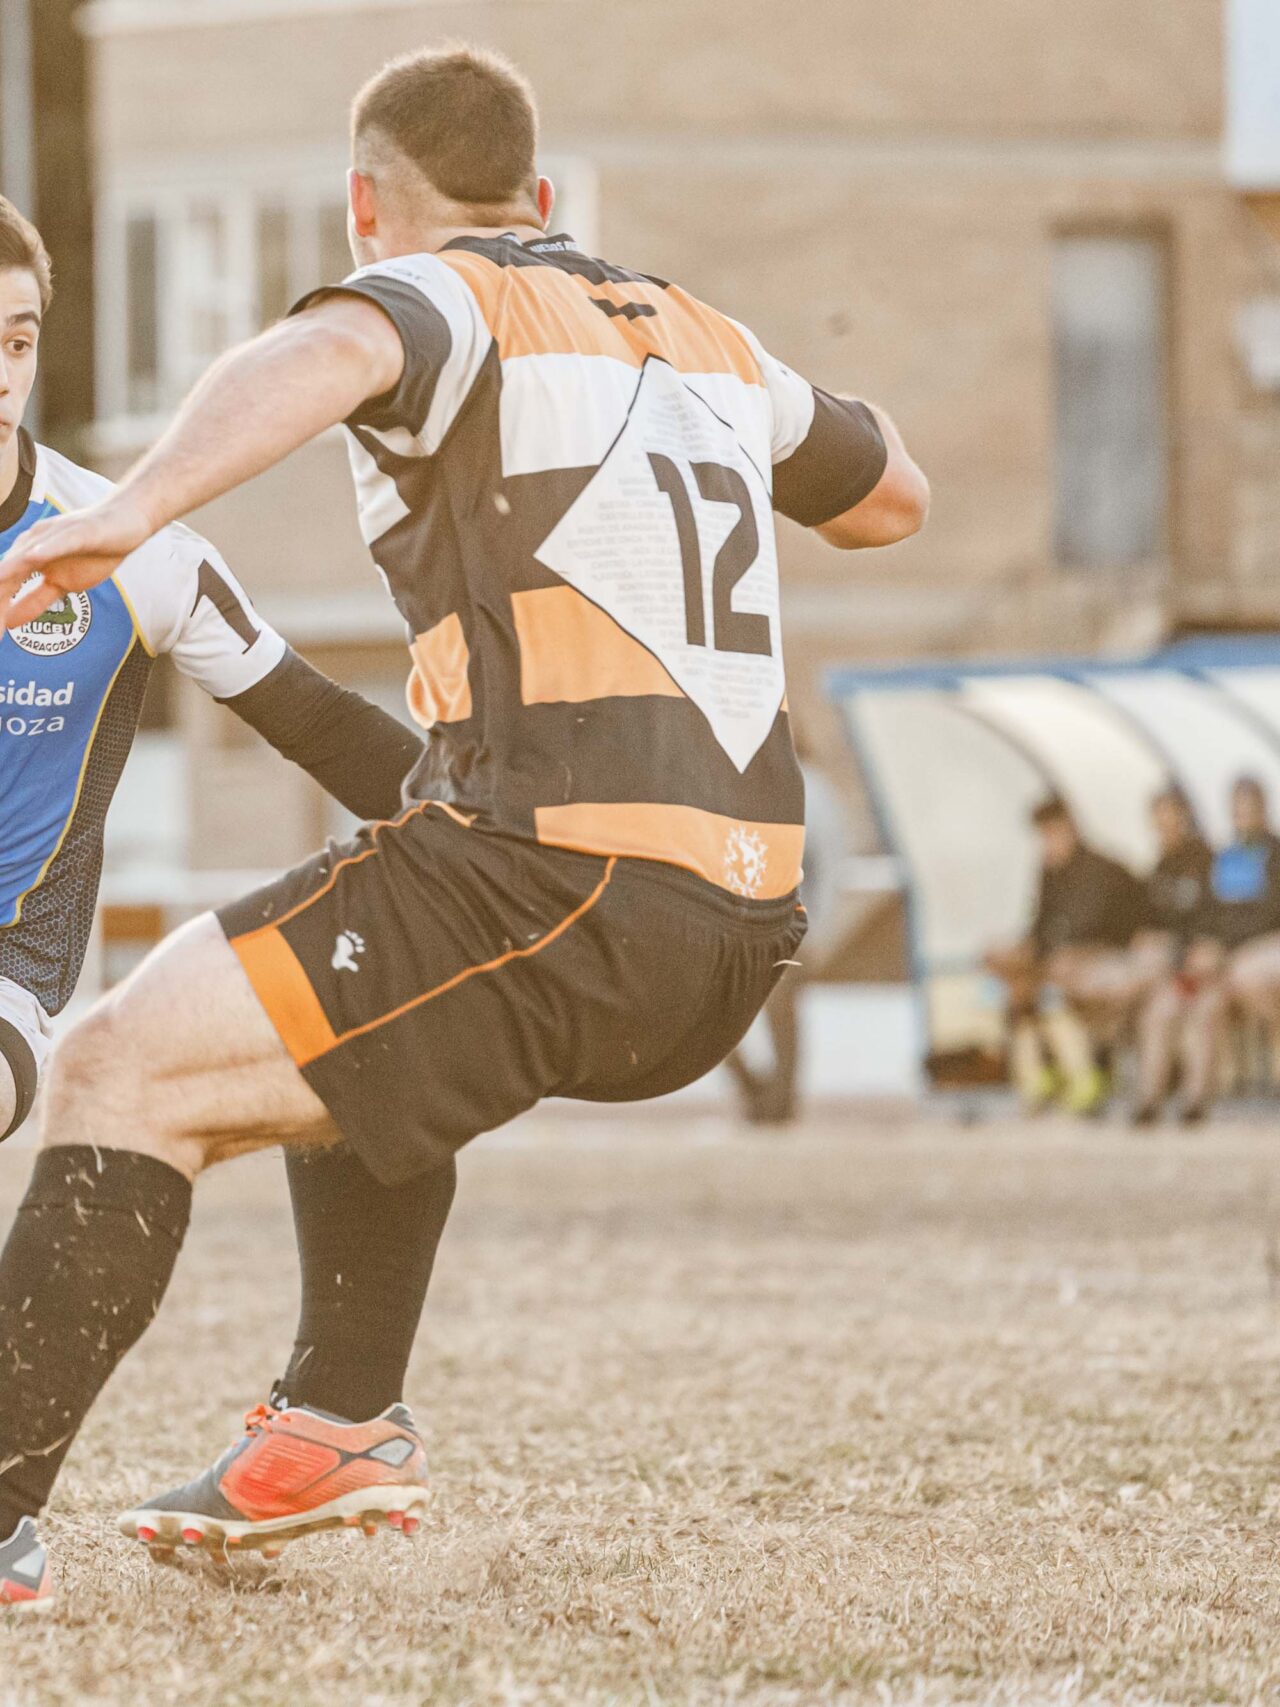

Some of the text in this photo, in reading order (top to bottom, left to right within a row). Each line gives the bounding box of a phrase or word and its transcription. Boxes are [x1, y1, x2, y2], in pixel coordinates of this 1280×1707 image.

[646, 451, 773, 658] 12
[77, 592, 90, 634] SITARIO
[21, 620, 74, 636] RUGBY
[19, 636, 74, 653] ZARAGOZA
